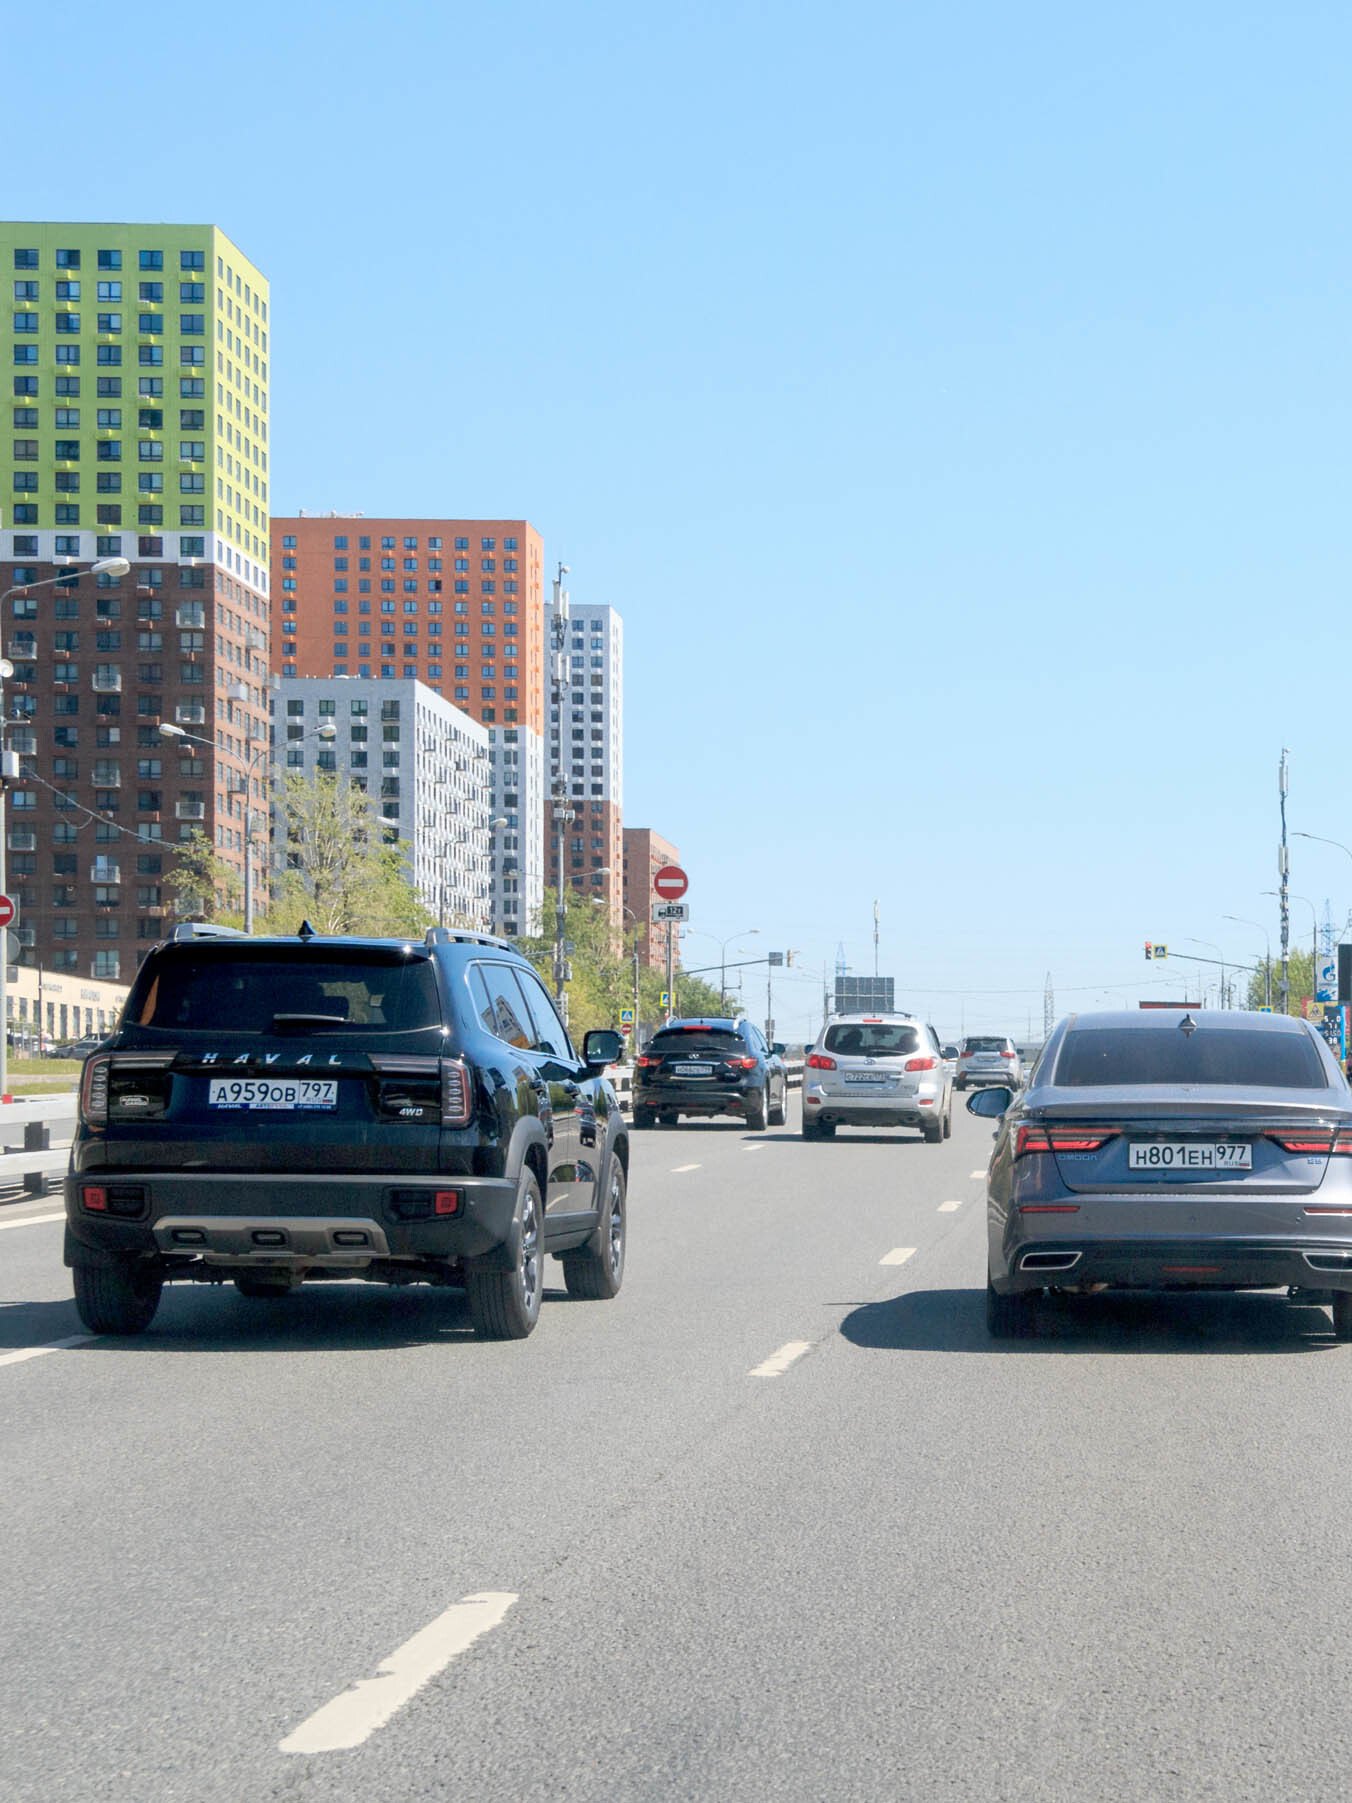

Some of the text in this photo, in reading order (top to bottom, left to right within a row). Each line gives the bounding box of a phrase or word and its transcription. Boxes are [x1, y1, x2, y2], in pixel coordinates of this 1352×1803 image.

[201, 1052, 343, 1065] HAVAL
[301, 1082, 333, 1098] 797
[399, 1107, 424, 1117] 4WD
[1217, 1145, 1246, 1160] 977
